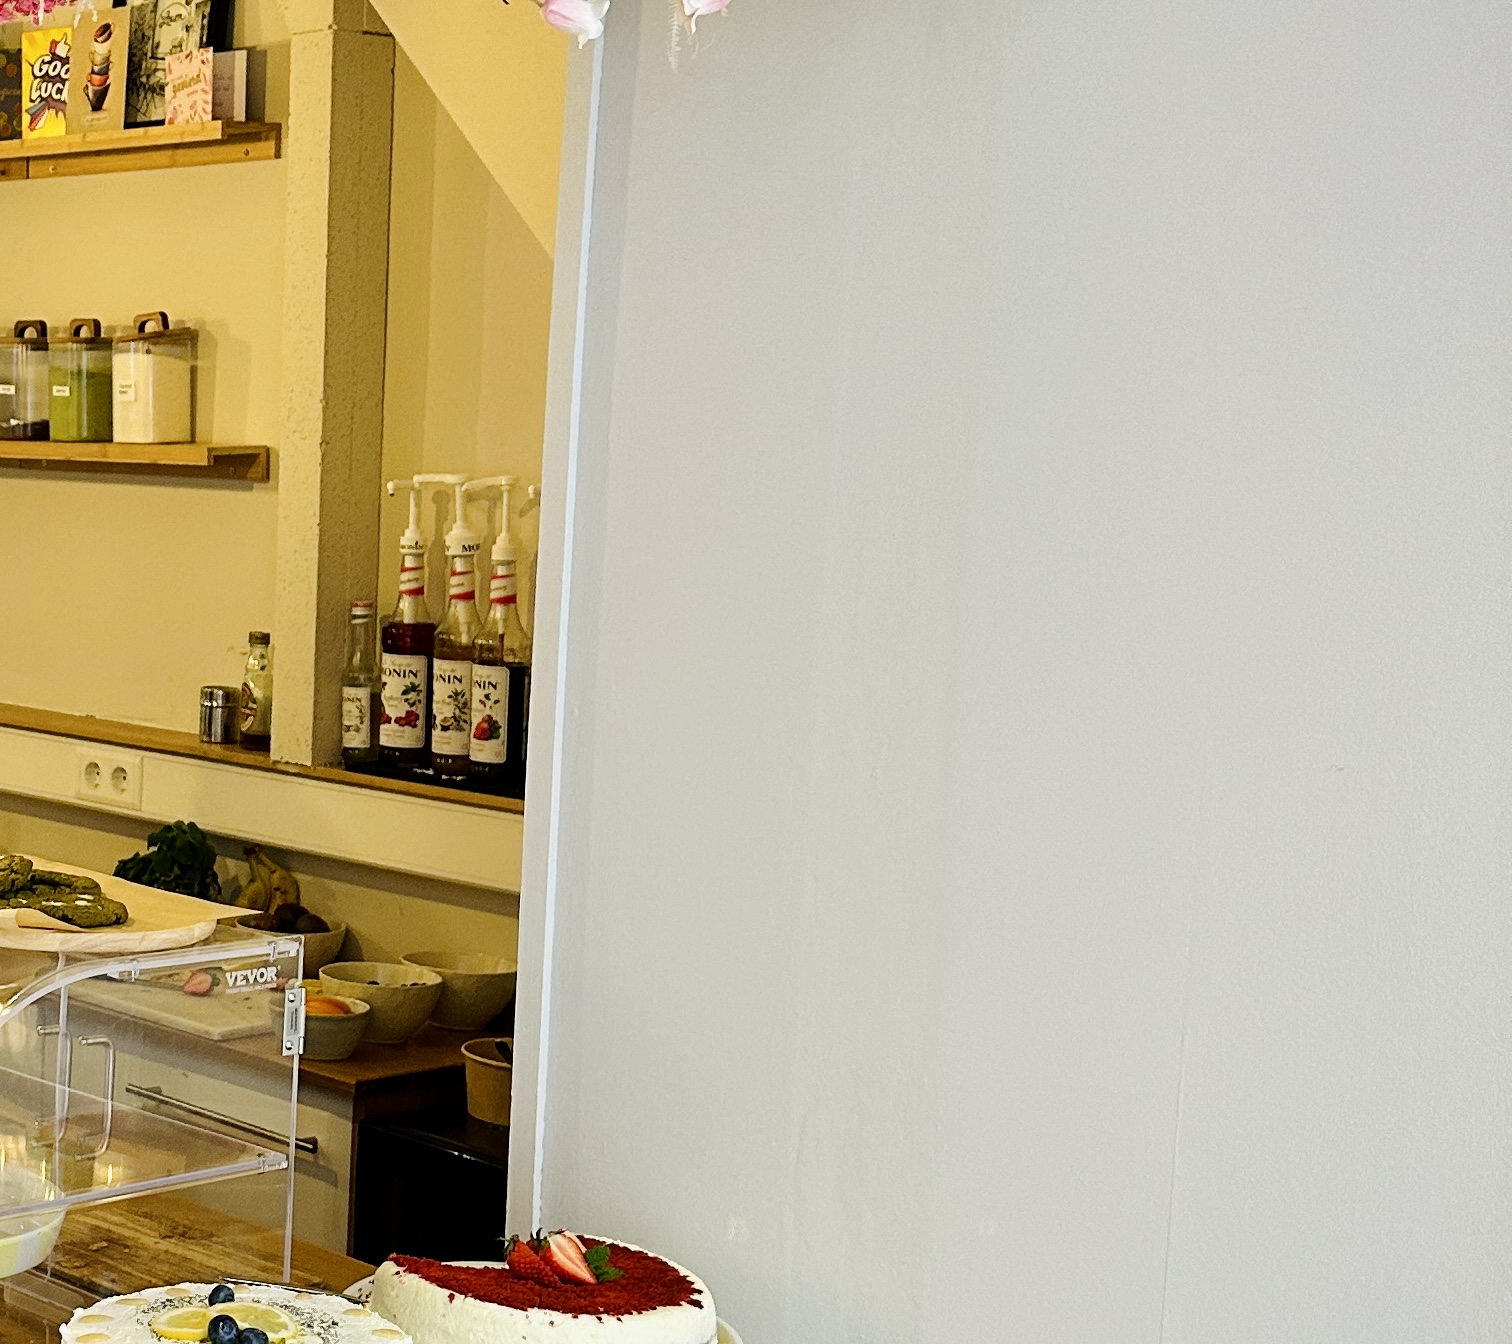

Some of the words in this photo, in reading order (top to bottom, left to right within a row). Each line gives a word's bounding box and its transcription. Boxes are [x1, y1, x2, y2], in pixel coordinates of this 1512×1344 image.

[33, 56, 70, 79] GOO
[383, 668, 418, 679] ONIN
[225, 966, 277, 987] VEVOR
